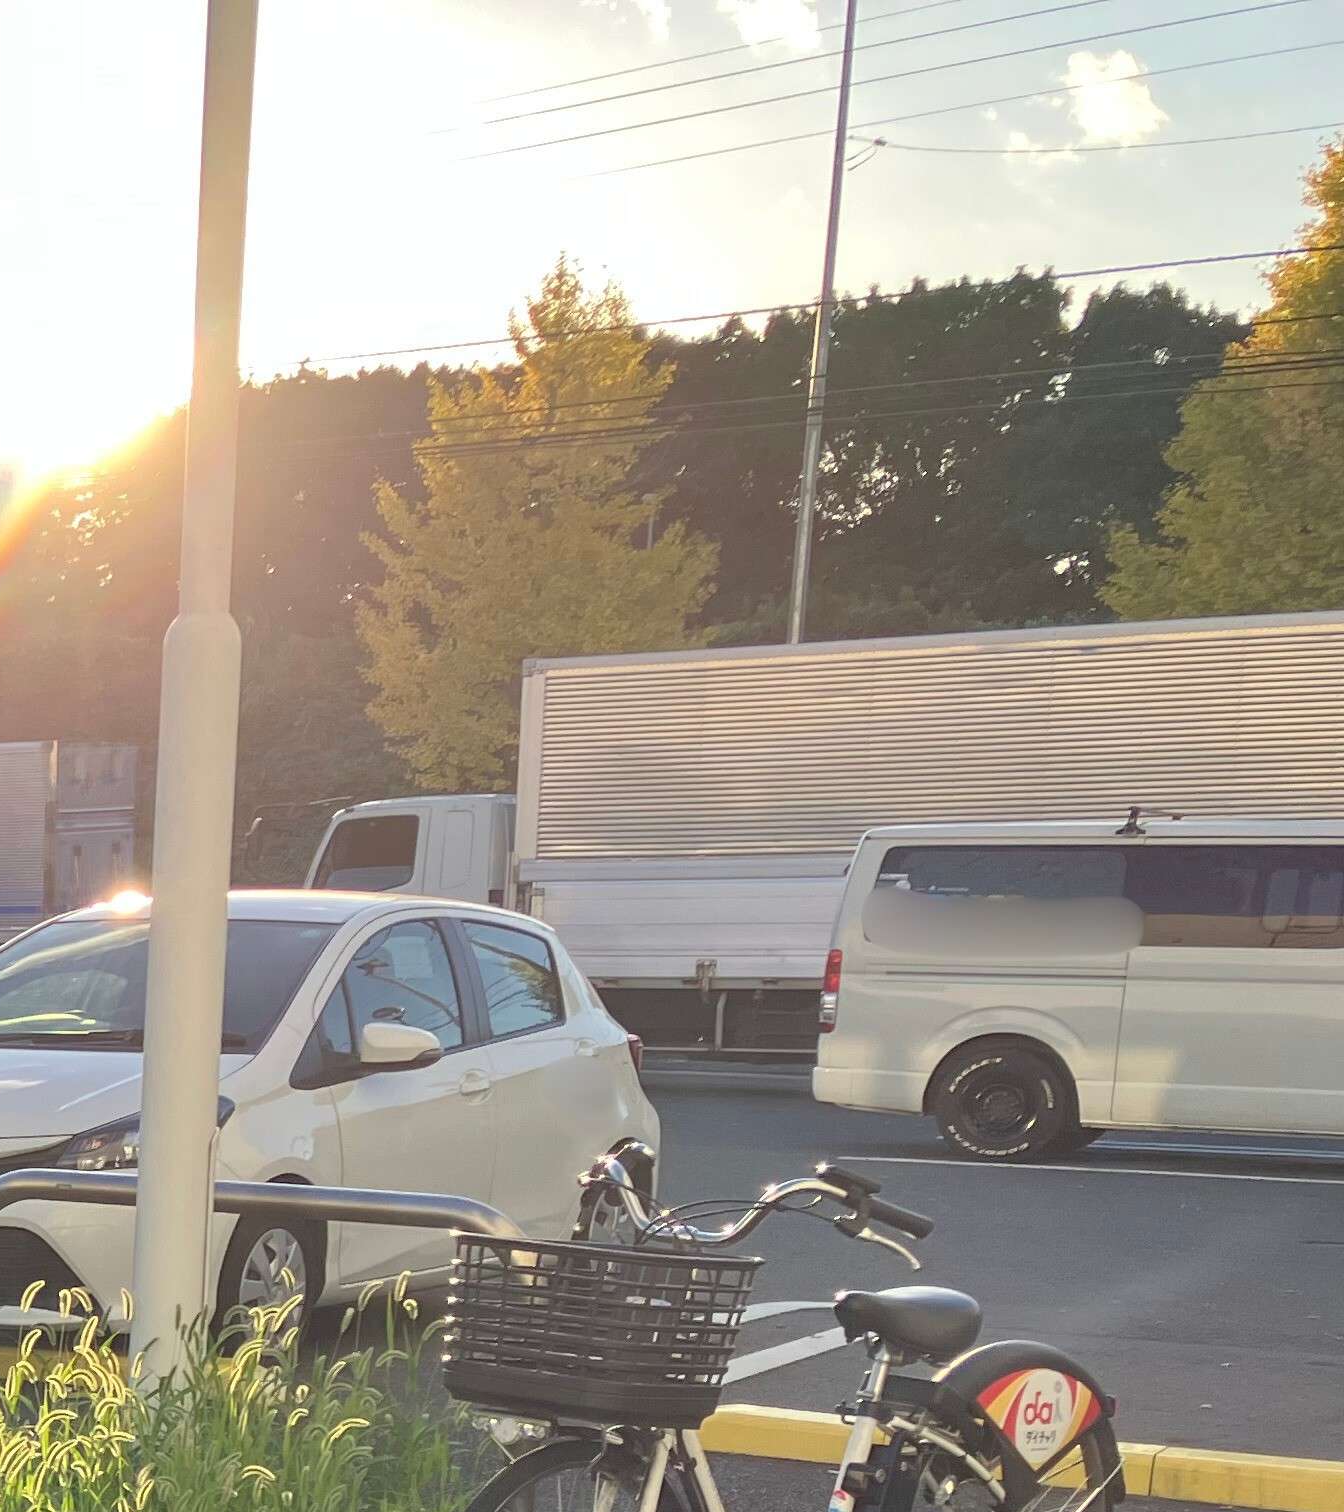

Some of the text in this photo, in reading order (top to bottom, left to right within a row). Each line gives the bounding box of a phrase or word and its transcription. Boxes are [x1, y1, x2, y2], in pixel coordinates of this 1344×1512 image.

[1023, 1380, 1063, 1425] dai
[1025, 1430, 1057, 1445] ダイチャリ
